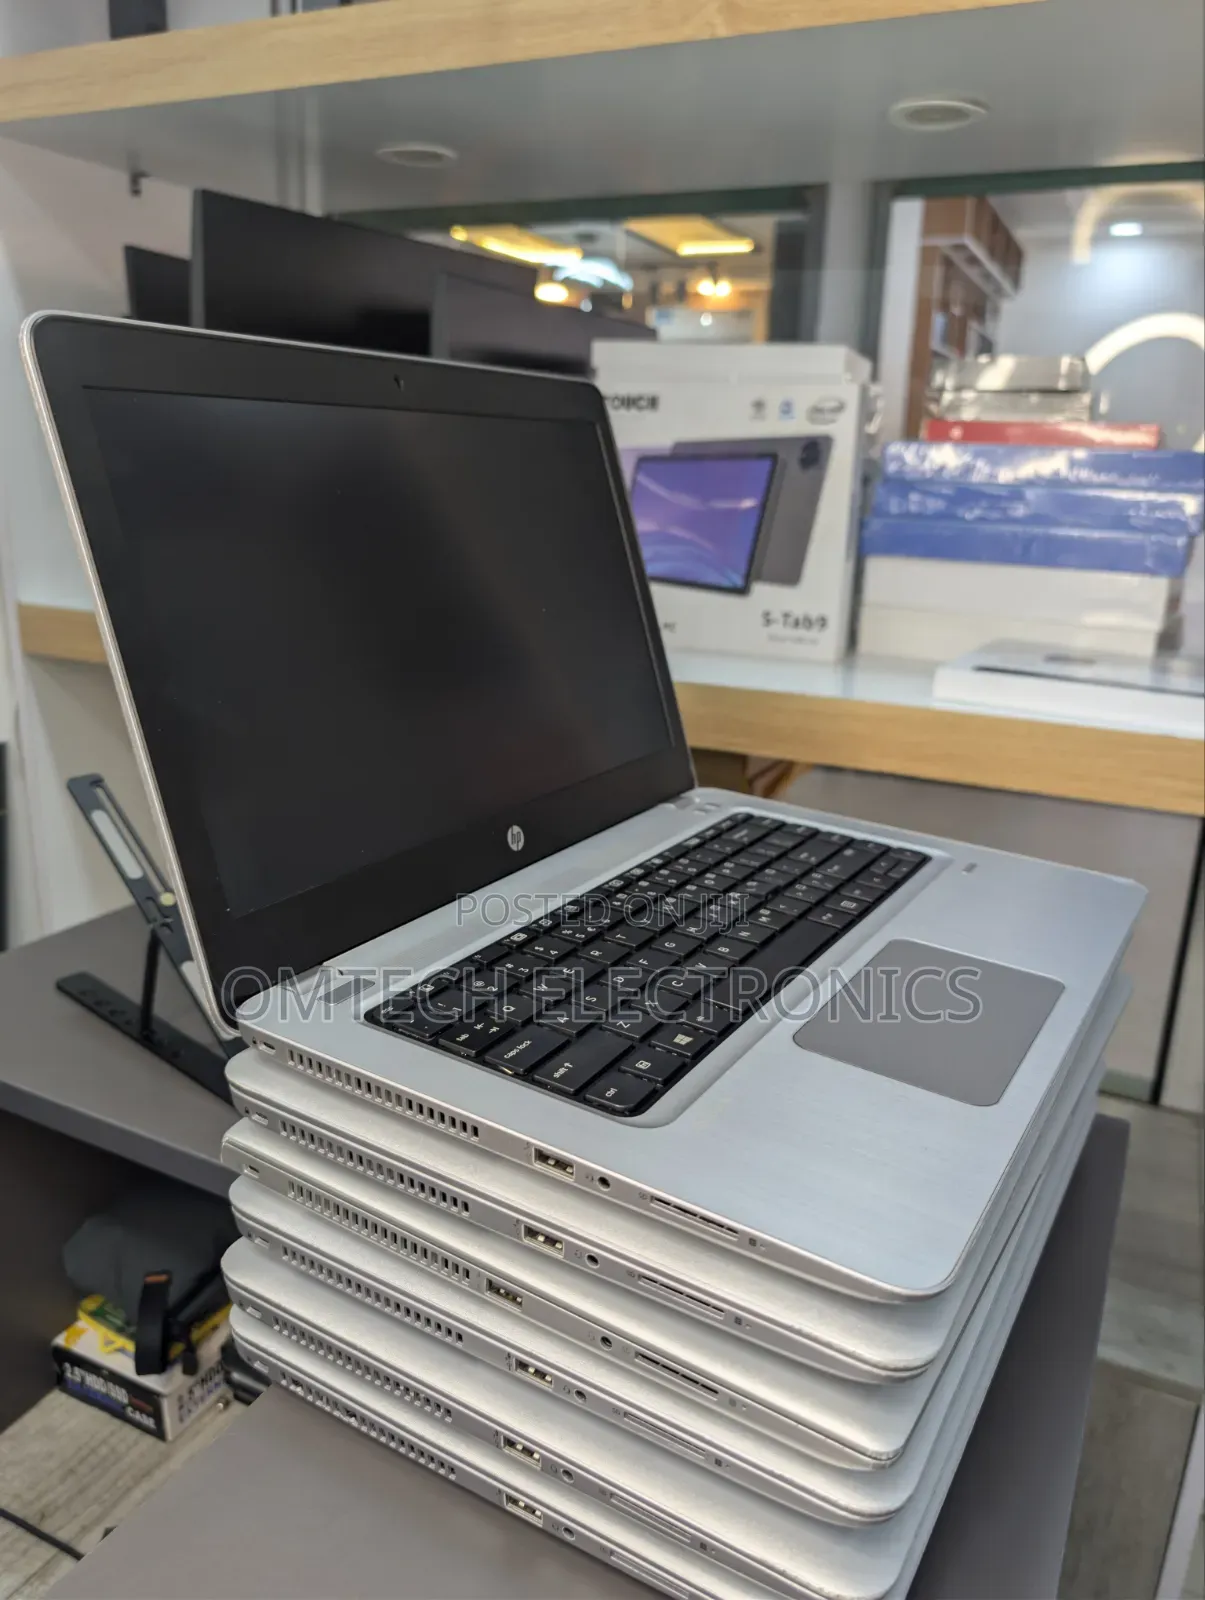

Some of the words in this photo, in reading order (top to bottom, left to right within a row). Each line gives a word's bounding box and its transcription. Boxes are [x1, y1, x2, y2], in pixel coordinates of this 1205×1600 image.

[507, 824, 525, 851] hp
[456, 1033, 470, 1042] tab
[503, 1045, 519, 1059] caps
[517, 1039, 532, 1052] lock
[553, 1066, 569, 1079] shift
[605, 1087, 618, 1097] ctrl
[126, 1406, 157, 1430] CASE
